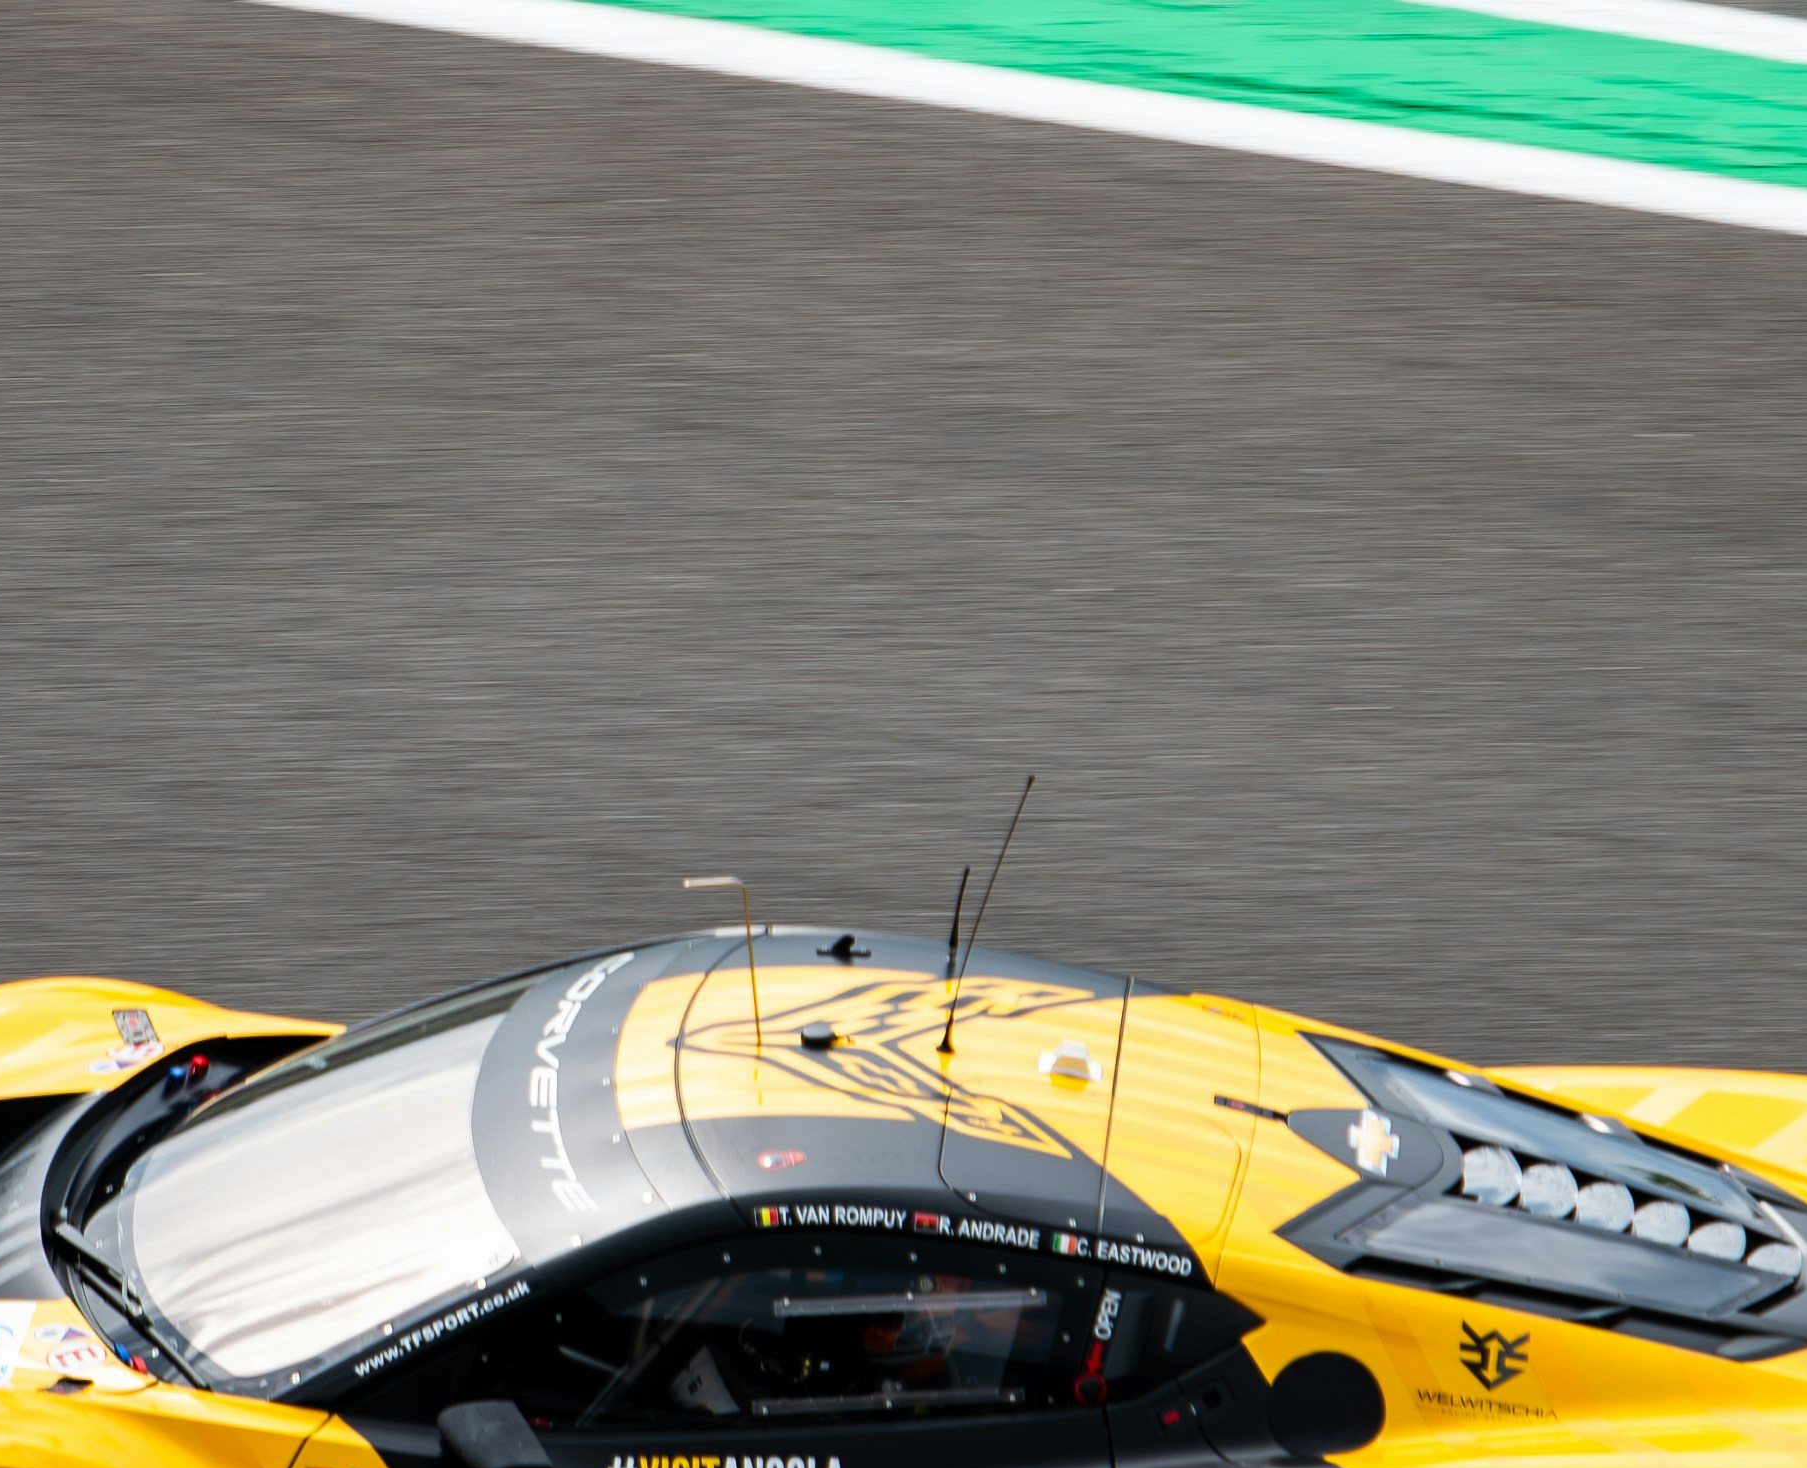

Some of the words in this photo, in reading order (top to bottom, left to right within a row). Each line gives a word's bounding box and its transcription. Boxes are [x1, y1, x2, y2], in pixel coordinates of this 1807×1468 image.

[779, 1206, 793, 1226] T.
[797, 1206, 831, 1227] VAN
[833, 1207, 908, 1231] ROMPUY
[938, 1217, 955, 1236] R.
[958, 1219, 1041, 1250] ANDRADE
[1076, 1238, 1092, 1258] C.
[1096, 1240, 1193, 1277] EASTWOOD
[353, 1280, 531, 1378] www.TFSPORT.co.uk
[1094, 1288, 1123, 1341] OPEN
[1416, 1387, 1558, 1421] WELWITSCHIA
